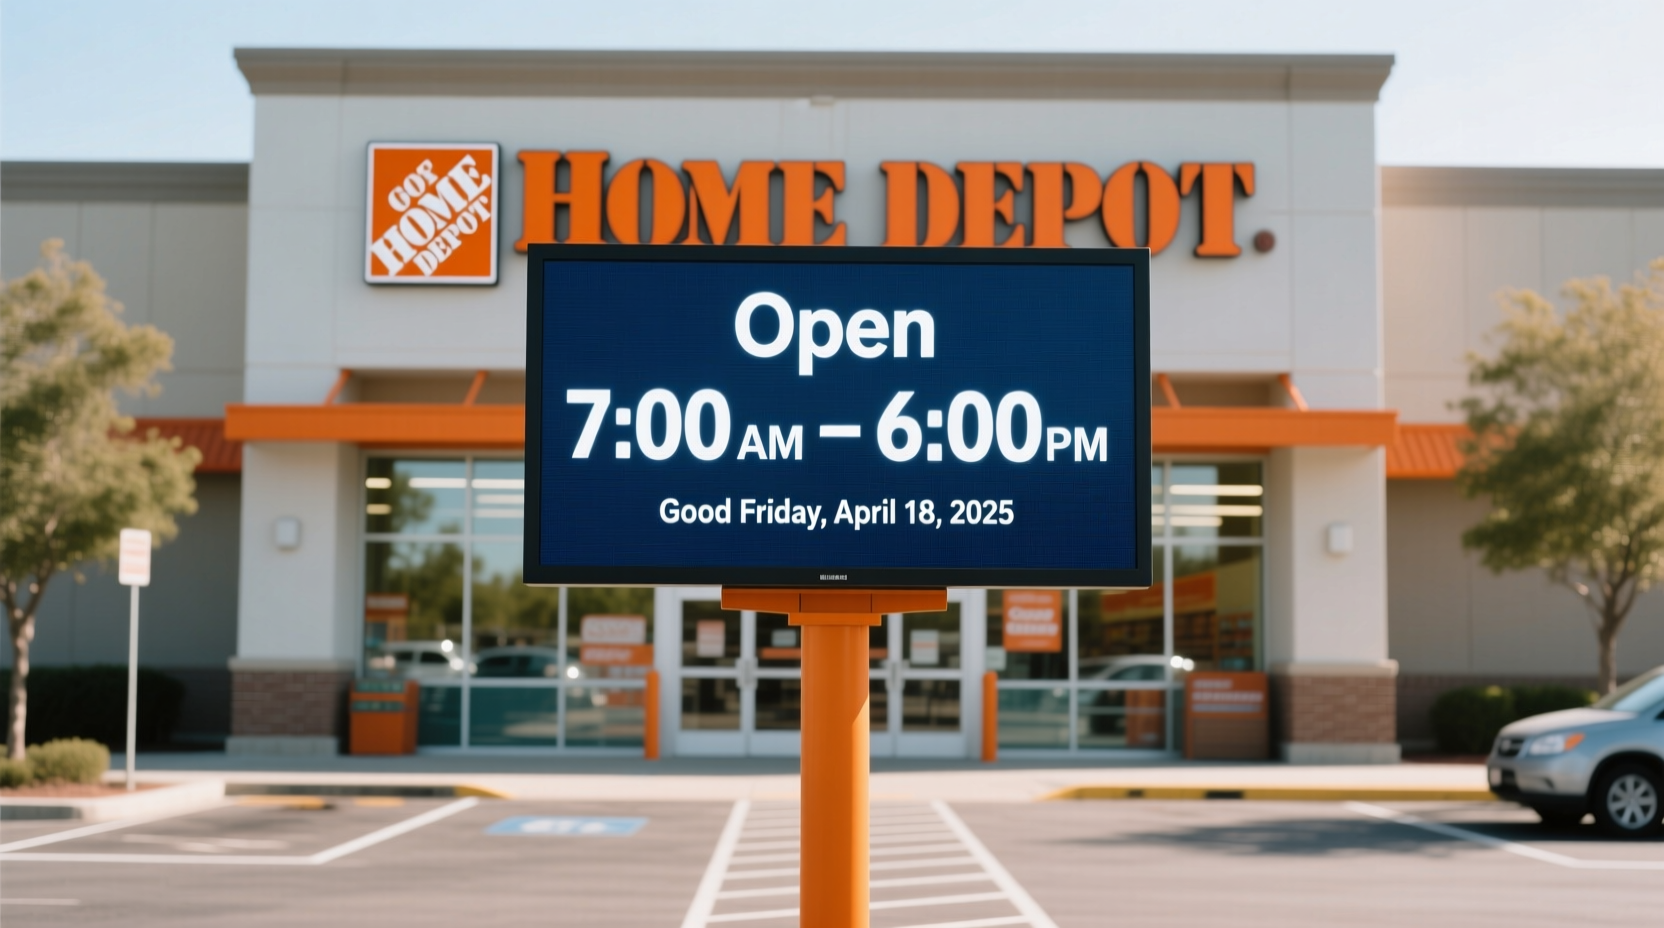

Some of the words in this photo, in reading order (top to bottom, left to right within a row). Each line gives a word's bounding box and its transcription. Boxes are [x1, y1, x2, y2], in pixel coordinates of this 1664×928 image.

[371, 153, 491, 277] HOME
[412, 195, 491, 277] DEPOT
[513, 150, 846, 253] HOME
[734, 291, 935, 376] Open
[566, 388, 731, 461] 7:00
[737, 424, 804, 461] AM
[876, 390, 1043, 463] 6:00
[1046, 426, 1108, 462] PM
[659, 497, 732, 525] Good
[740, 497, 828, 531] Friday,
[833, 498, 896, 531] April
[904, 499, 942, 530] 18,
[949, 499, 1015, 525] 2025
